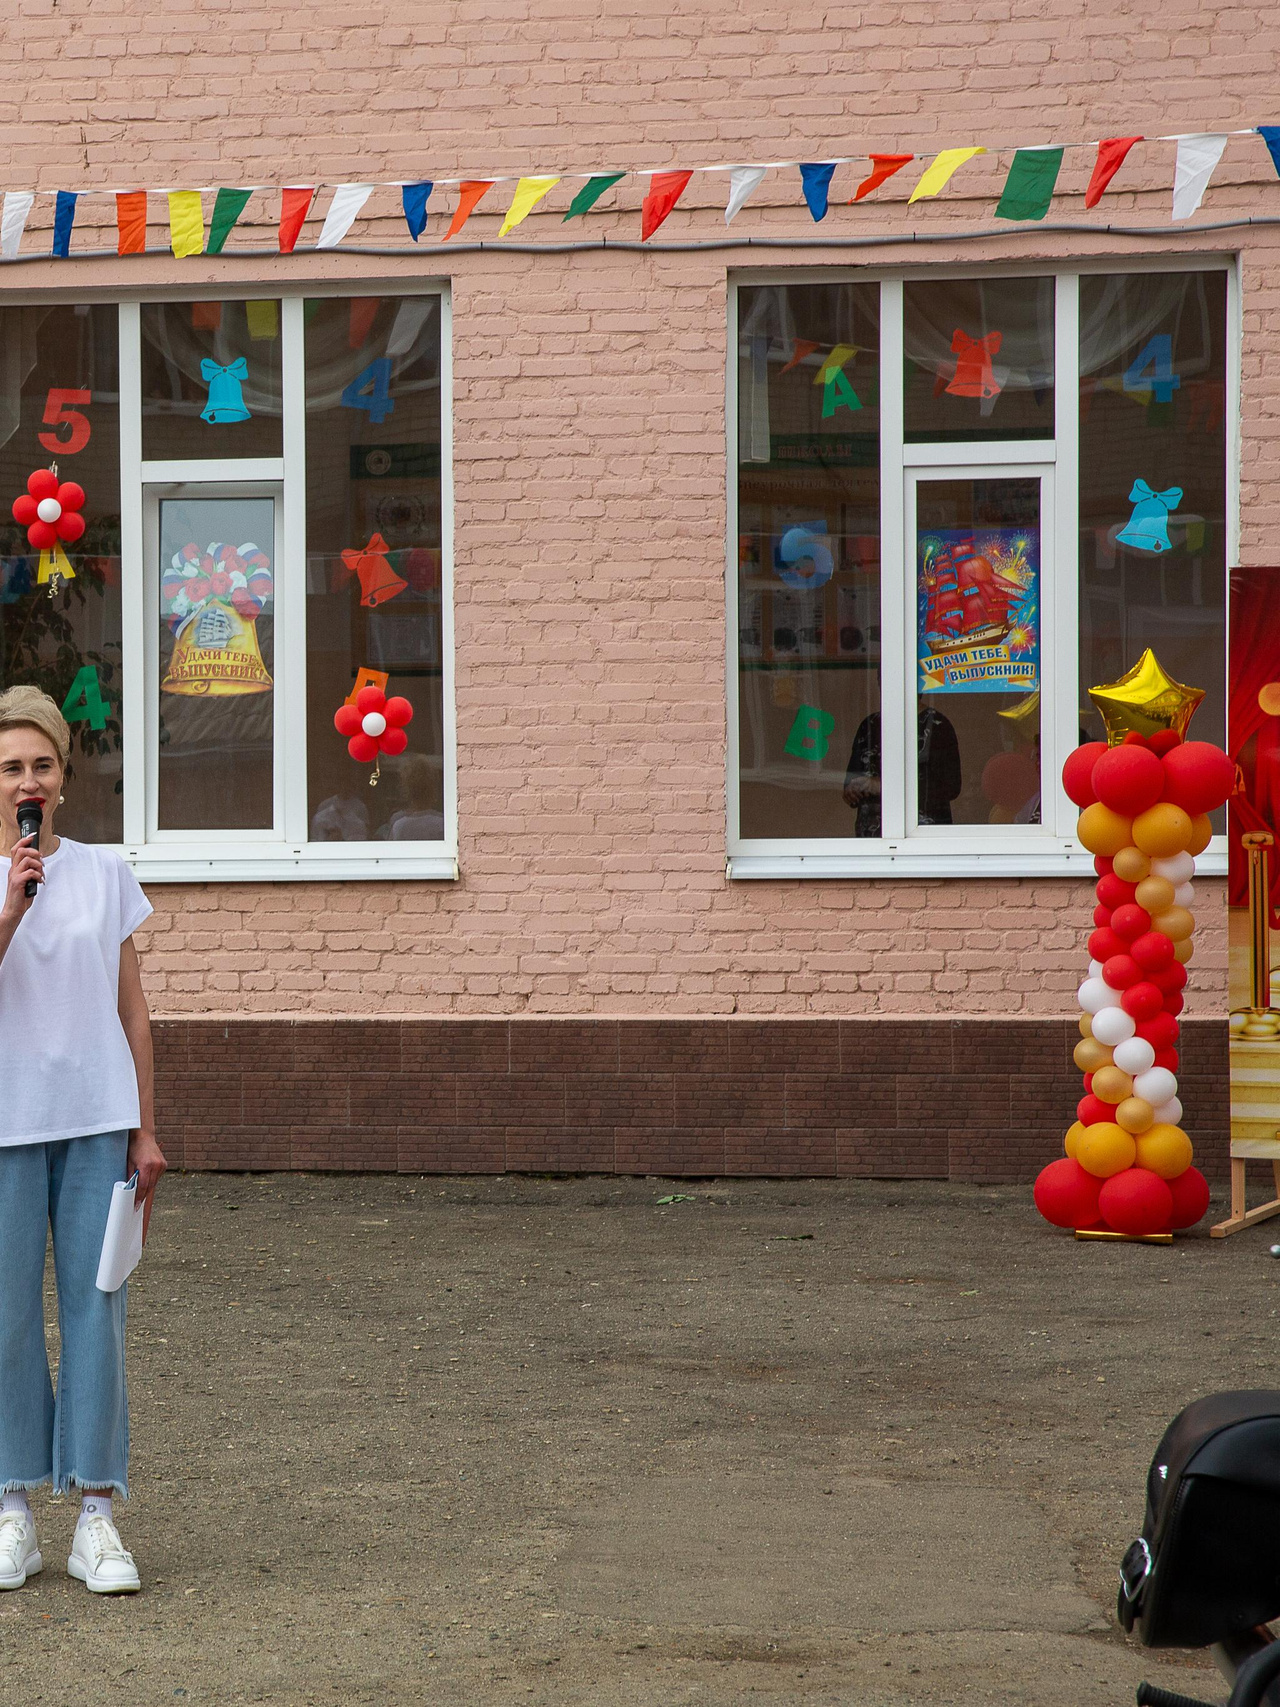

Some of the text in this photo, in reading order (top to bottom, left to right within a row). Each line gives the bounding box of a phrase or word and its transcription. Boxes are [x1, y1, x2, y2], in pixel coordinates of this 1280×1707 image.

[341, 357, 395, 424] 4
[822, 366, 864, 419] А
[1122, 333, 1181, 403] 4
[37, 387, 92, 455] 5
[779, 519, 834, 590] 5
[169, 663, 264, 680] ВЫПУСКНИК!
[924, 647, 1007, 671] УДАЧИ ТЕБЕ,
[949, 665, 1034, 682] ВЫПУСКНИК!
[61, 665, 112, 730] 4
[783, 704, 835, 762] В
